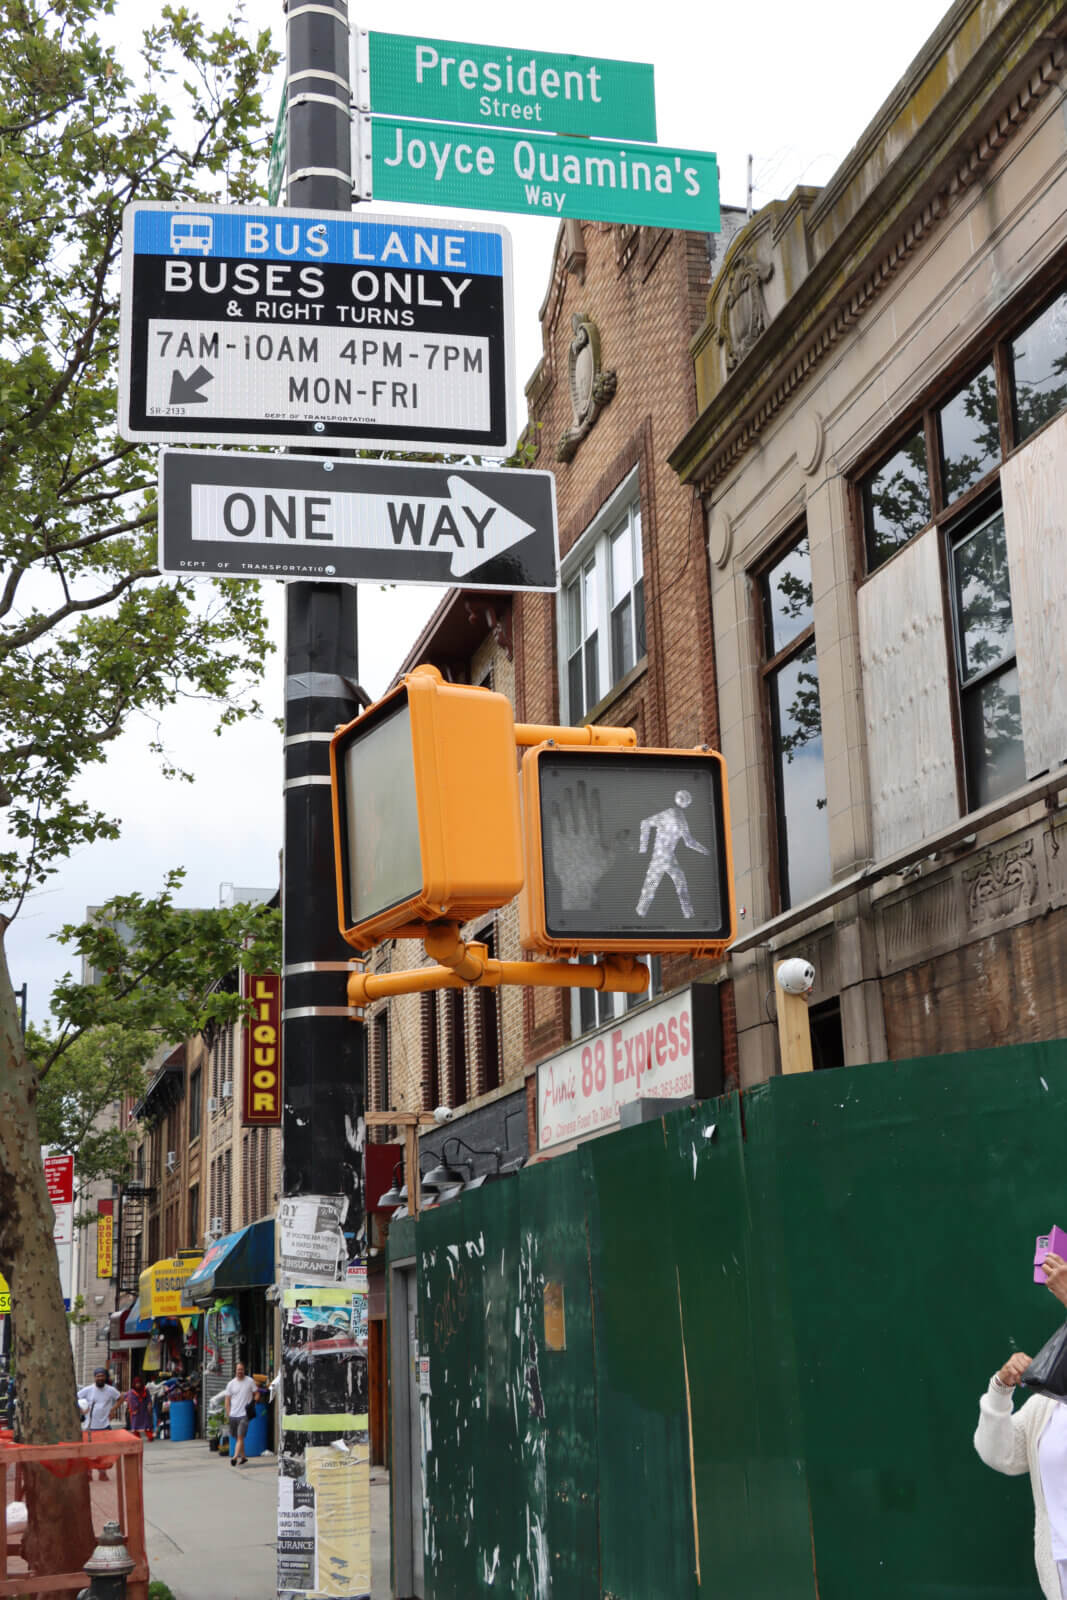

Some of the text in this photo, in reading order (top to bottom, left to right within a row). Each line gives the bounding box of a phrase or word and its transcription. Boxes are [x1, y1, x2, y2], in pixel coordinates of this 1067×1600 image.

[416, 45, 601, 102] President
[480, 97, 542, 121] Street
[384, 128, 700, 196] Joyce Quamina's
[525, 185, 566, 212] Way
[245, 222, 467, 268] BUS LANE
[165, 260, 473, 308] BUSES ONLY
[226, 301, 415, 326] & RIGHT TURNS
[156, 331, 483, 373] 7AM-10AM 4PM-7PM
[150, 407, 186, 416] SR-2133
[289, 377, 418, 409] MON-FRI
[303, 414, 376, 423] TRANSPORTATION
[223, 492, 497, 549] ONE WAY
[241, 562, 324, 573] TRANSPORTATIO
[253, 981, 277, 1111] LIQUOR
[581, 1011, 691, 1097] 88 Express
[286, 1259, 335, 1272] INSURANCE
